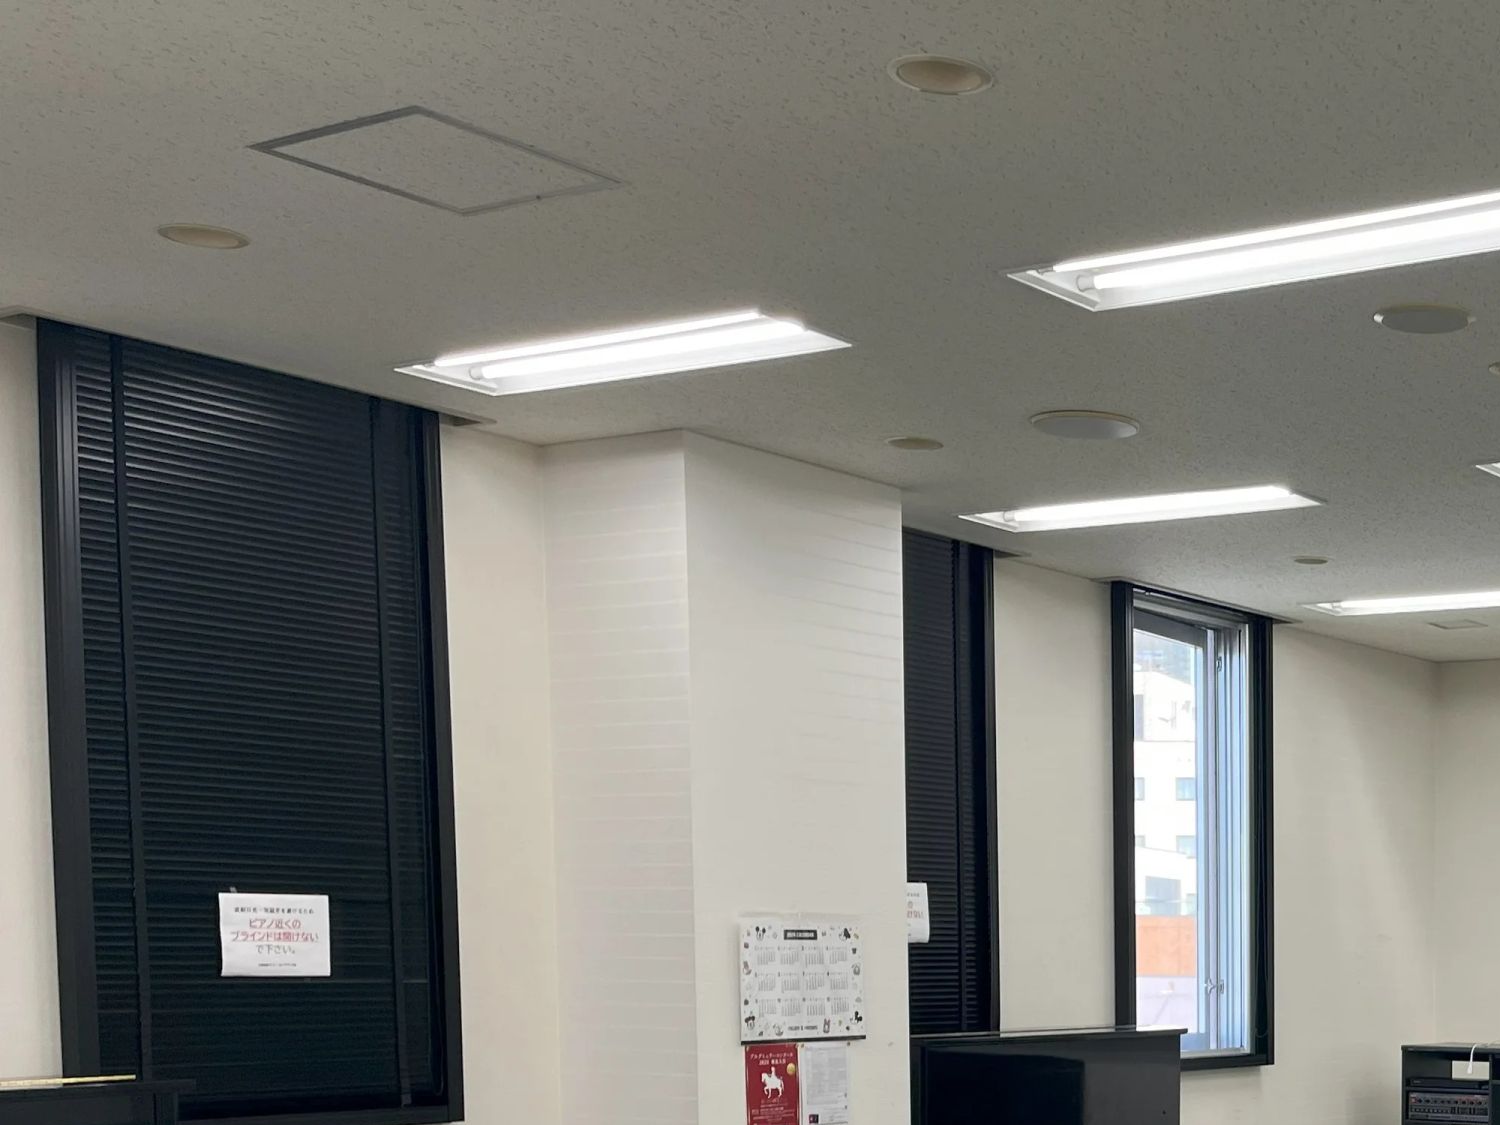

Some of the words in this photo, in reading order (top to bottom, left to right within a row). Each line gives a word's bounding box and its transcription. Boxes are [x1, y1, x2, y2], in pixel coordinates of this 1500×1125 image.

[249, 918, 301, 929] ピアノ近くの
[230, 930, 319, 942] ブラインドは開けない
[256, 944, 296, 954] で下さい。
